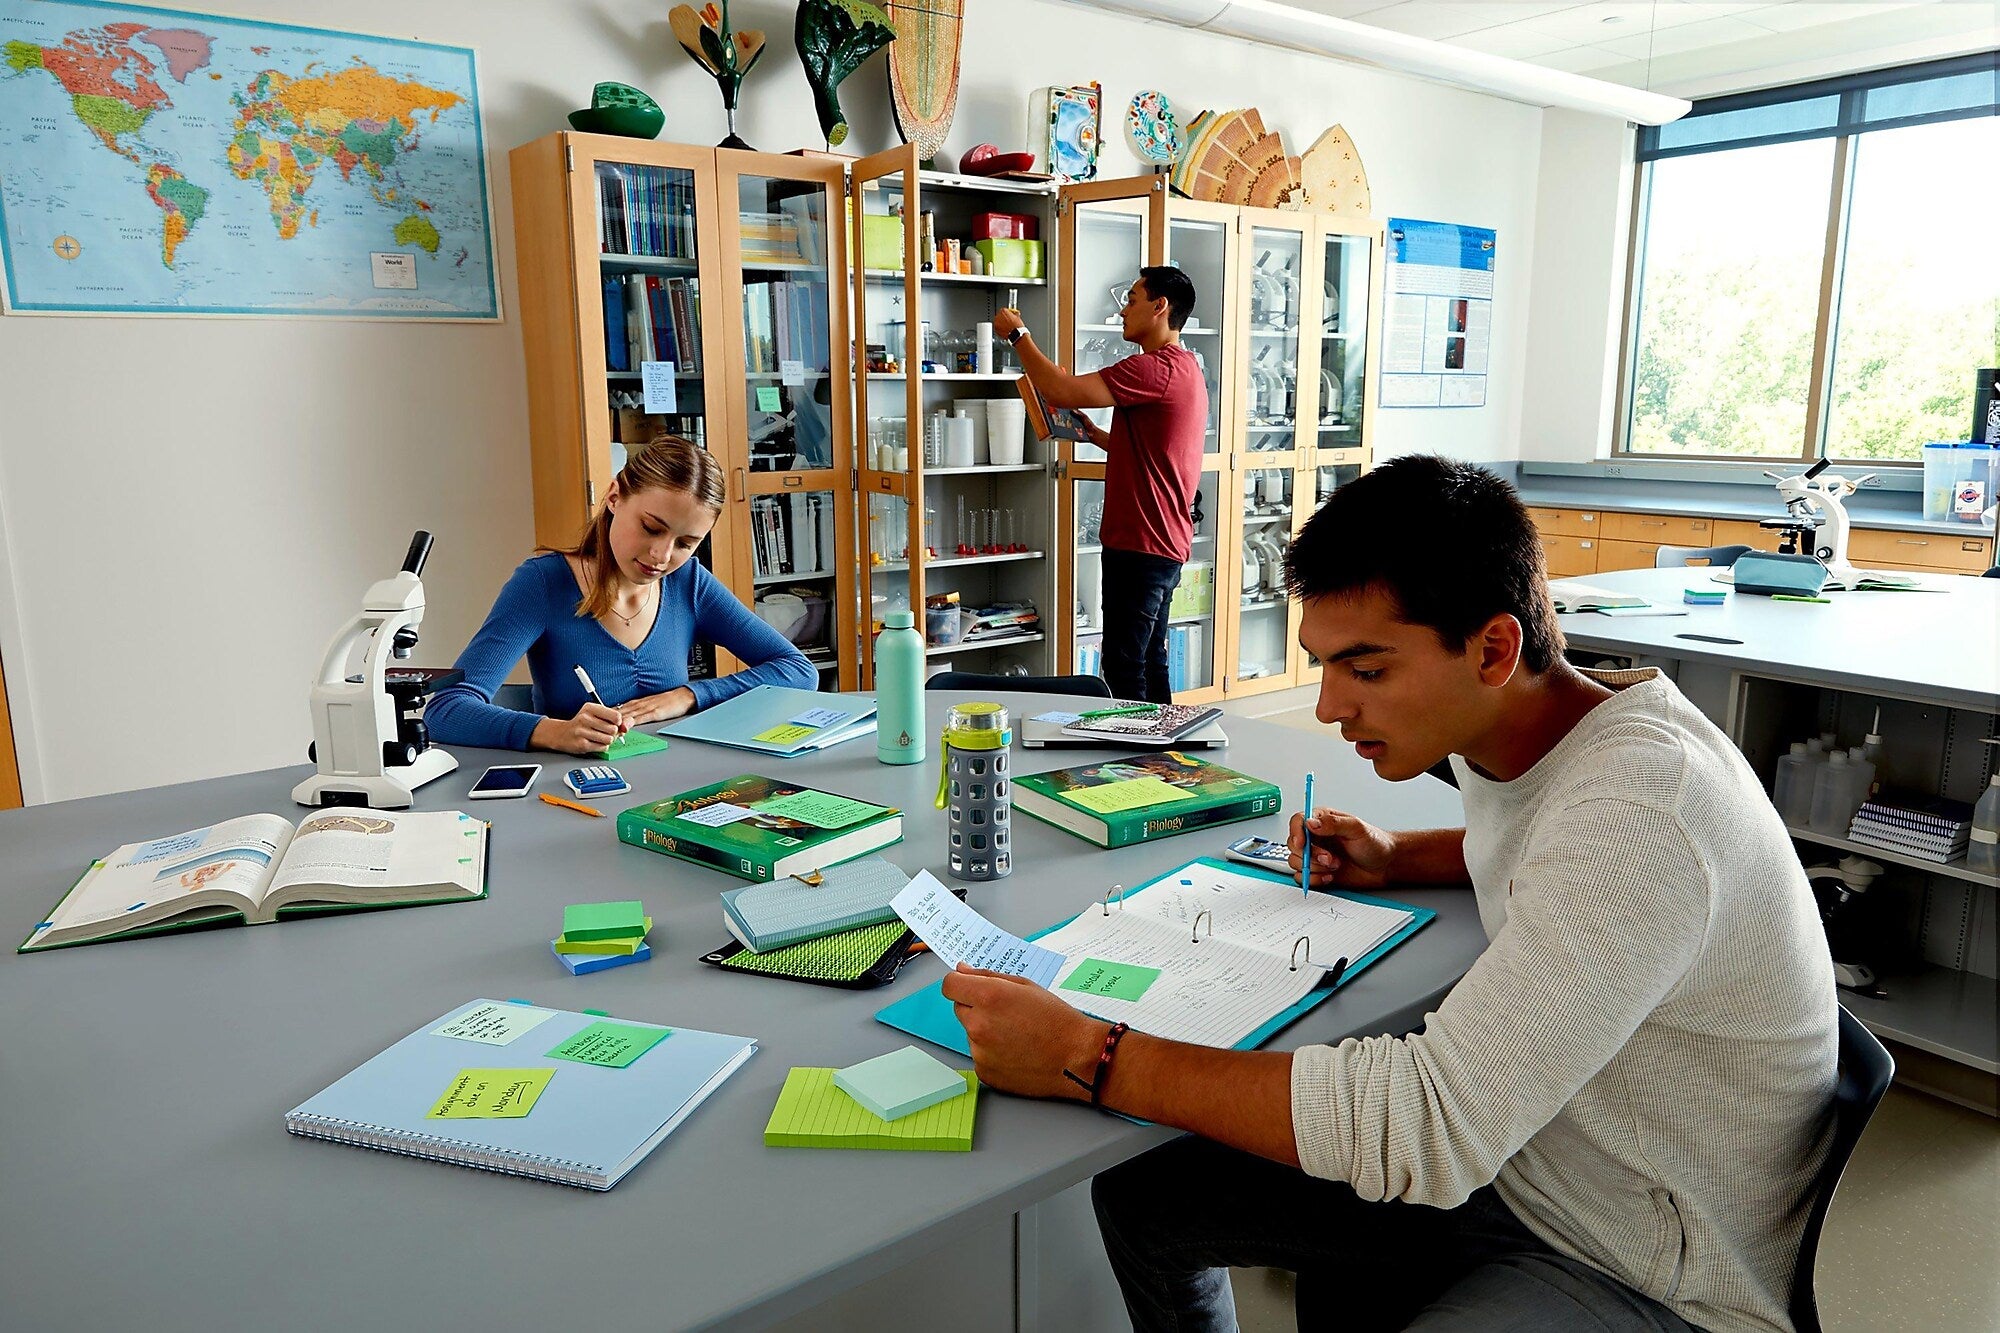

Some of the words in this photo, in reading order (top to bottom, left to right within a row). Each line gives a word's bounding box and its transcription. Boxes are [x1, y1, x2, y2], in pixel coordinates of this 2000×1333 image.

[1149, 816, 1184, 833] Biology
[647, 829, 678, 852] Biology
[1078, 967, 1105, 991] Vascular
[1100, 975, 1122, 993] Tissue
[463, 1093, 481, 1108] due
[477, 1081, 489, 1091] on
[492, 1080, 533, 1113] Monday
